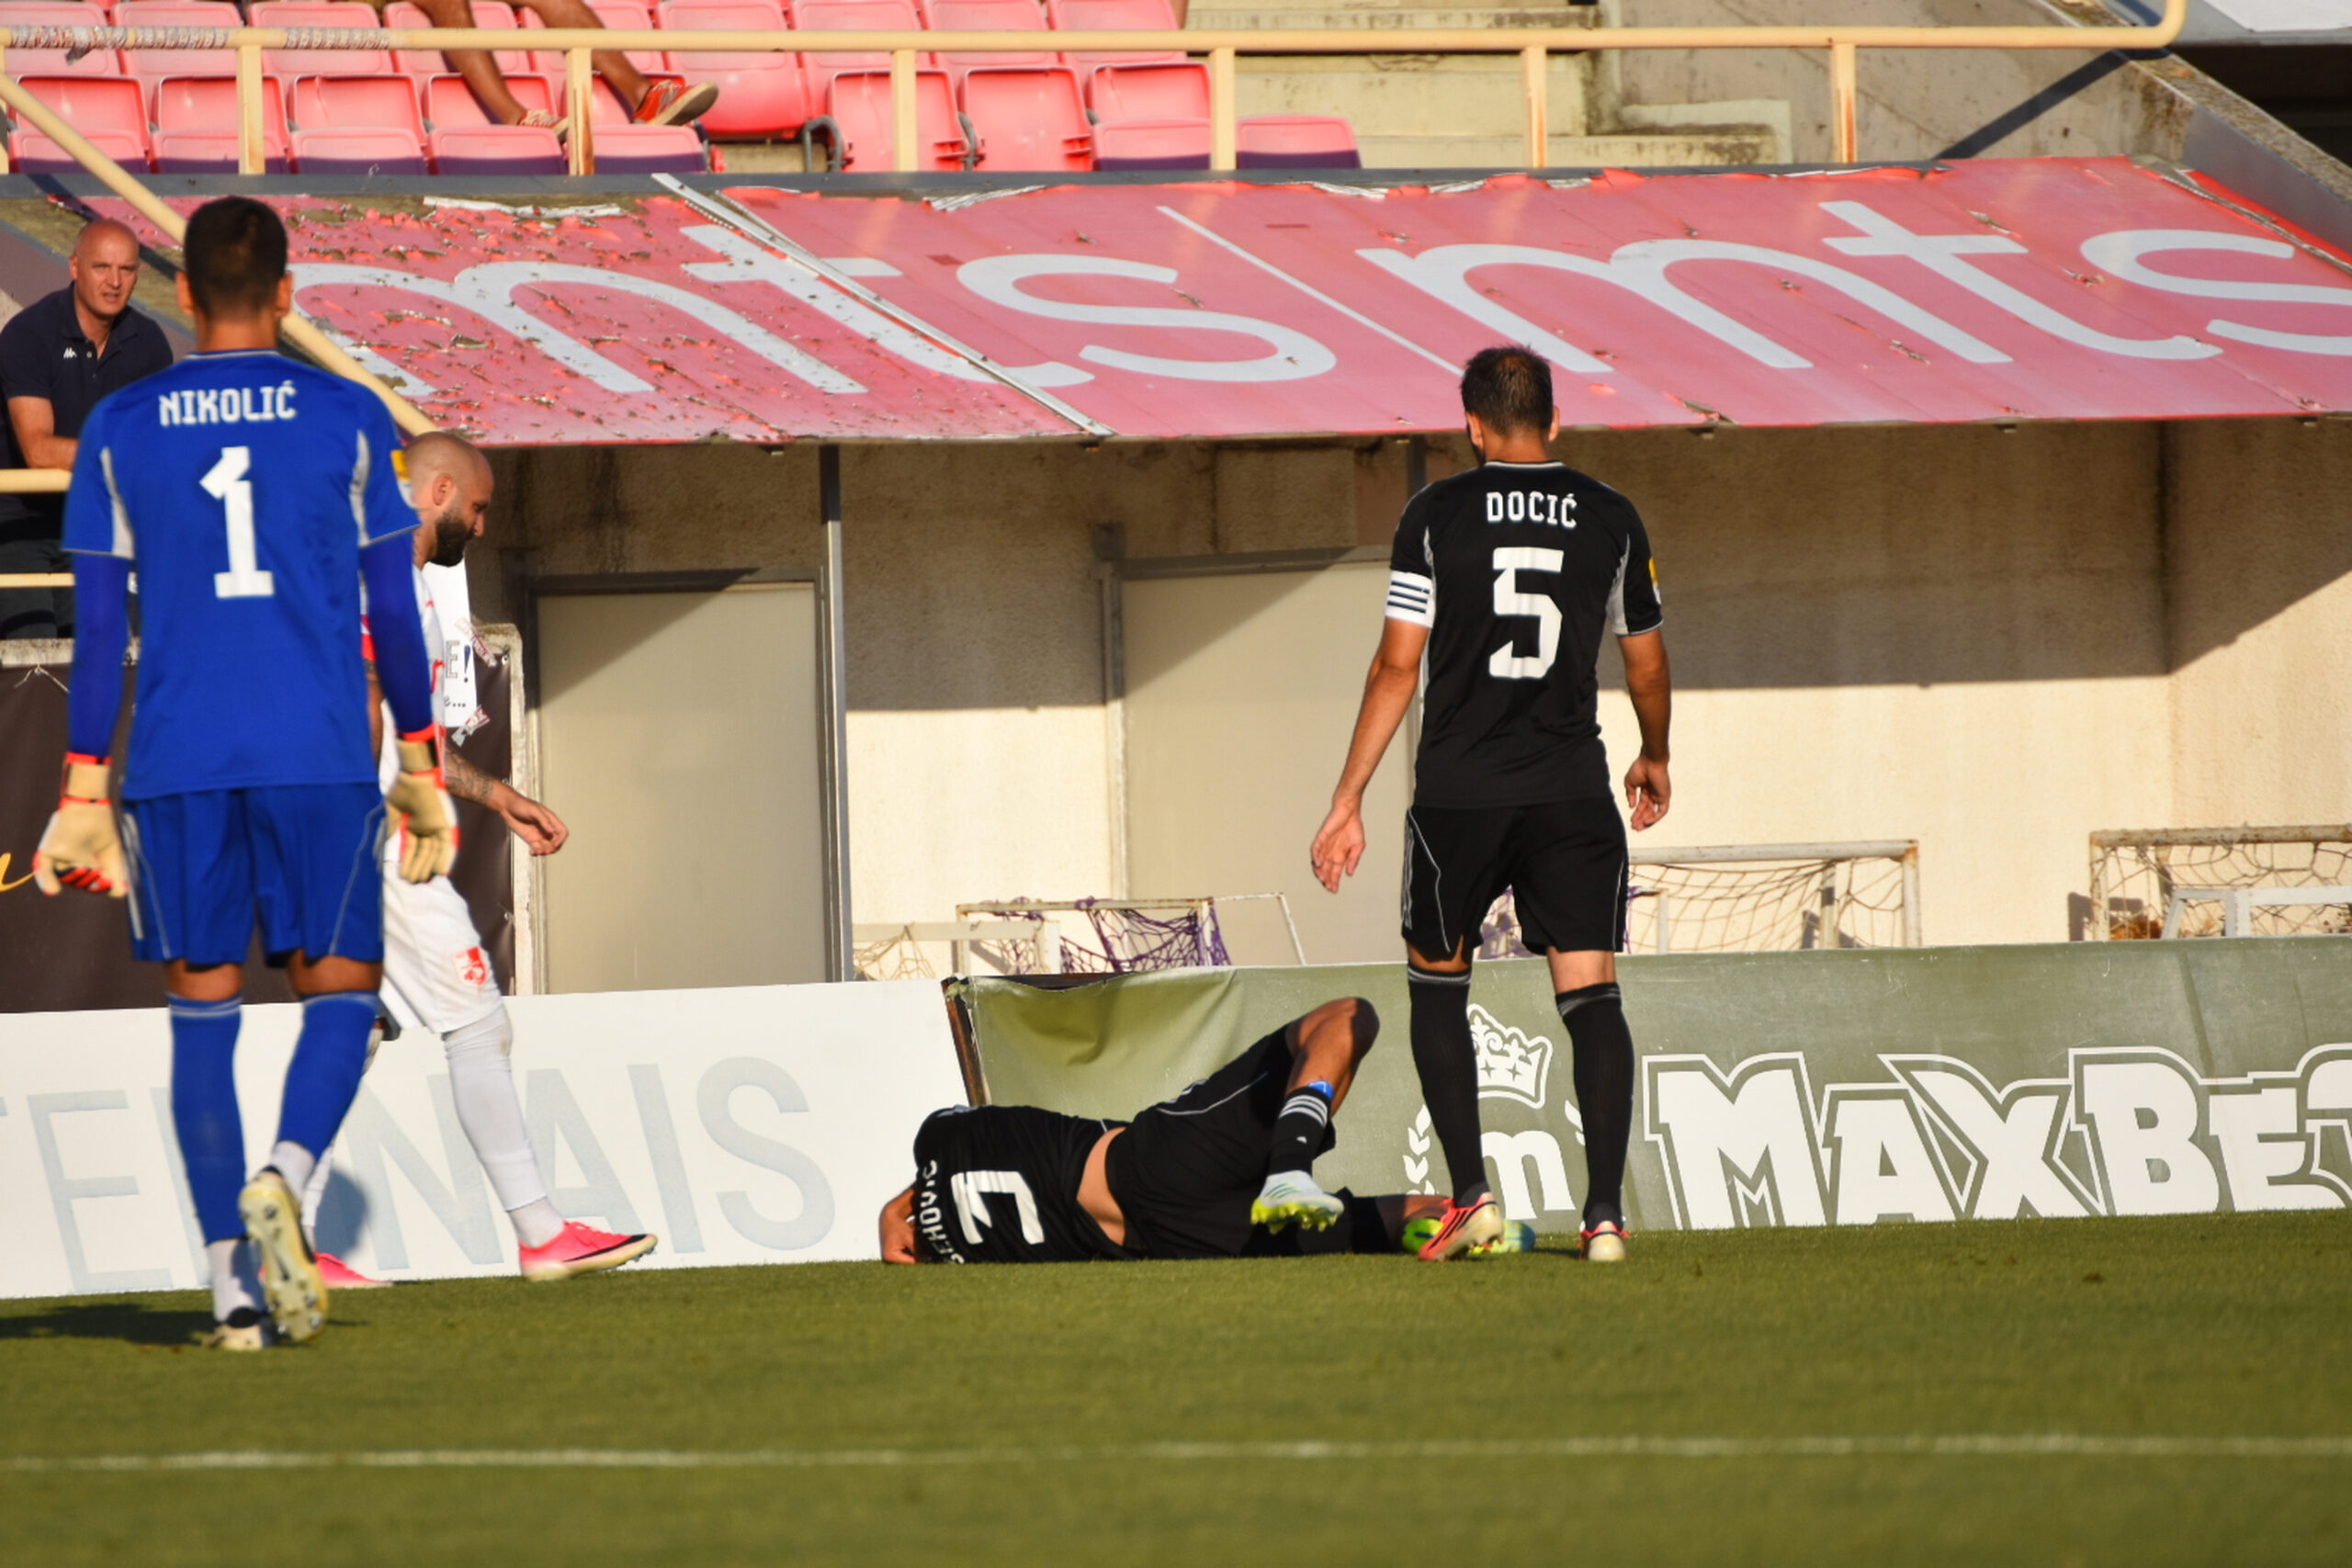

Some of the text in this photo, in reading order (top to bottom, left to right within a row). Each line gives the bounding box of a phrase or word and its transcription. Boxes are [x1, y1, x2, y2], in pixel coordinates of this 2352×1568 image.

[288, 223, 1338, 395] mts
[1355, 199, 2352, 374] mts
[158, 379, 298, 427] NIKOLIĆ
[198, 446, 275, 599] 1
[1486, 490, 1577, 530] DOCIĆ
[1488, 547, 1565, 680] 5
[0, 1056, 835, 1293] ENAIS
